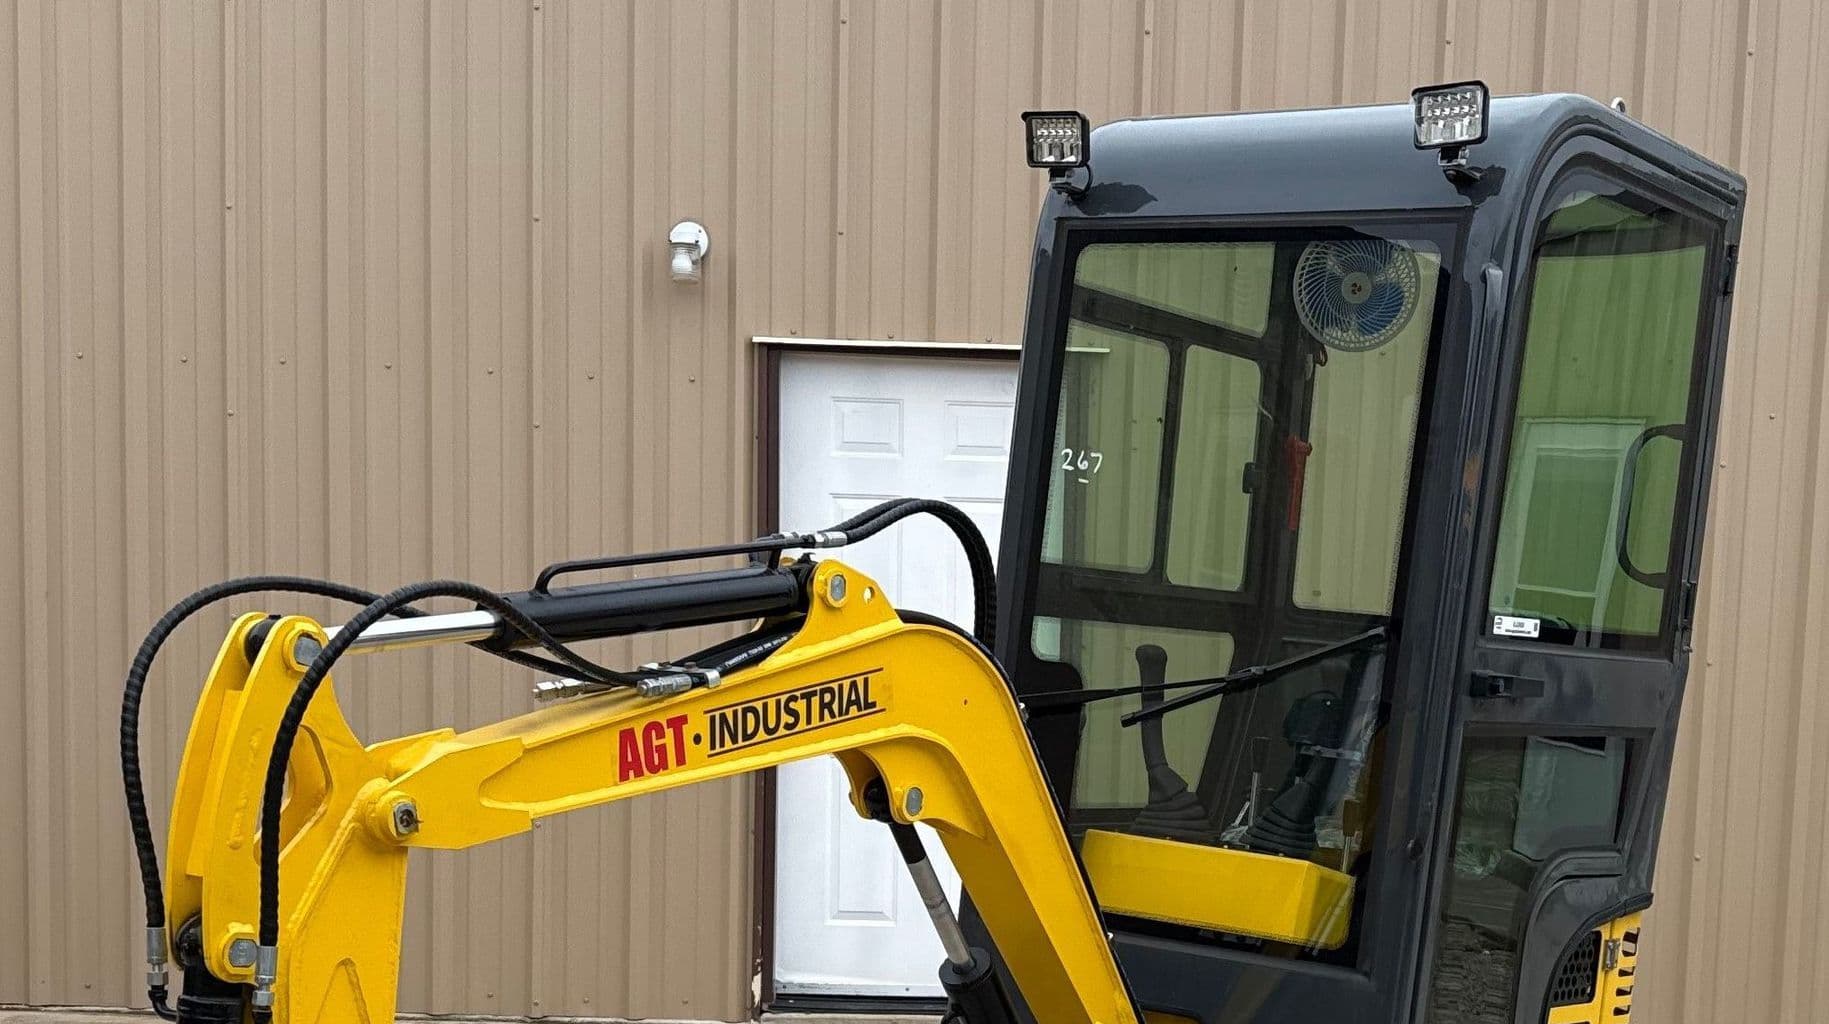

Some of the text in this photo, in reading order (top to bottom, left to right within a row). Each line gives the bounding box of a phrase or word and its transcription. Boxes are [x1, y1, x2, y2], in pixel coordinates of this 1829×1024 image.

[1061, 448, 1103, 473] 267
[618, 676, 877, 783] AGT INDUSTRIAL
